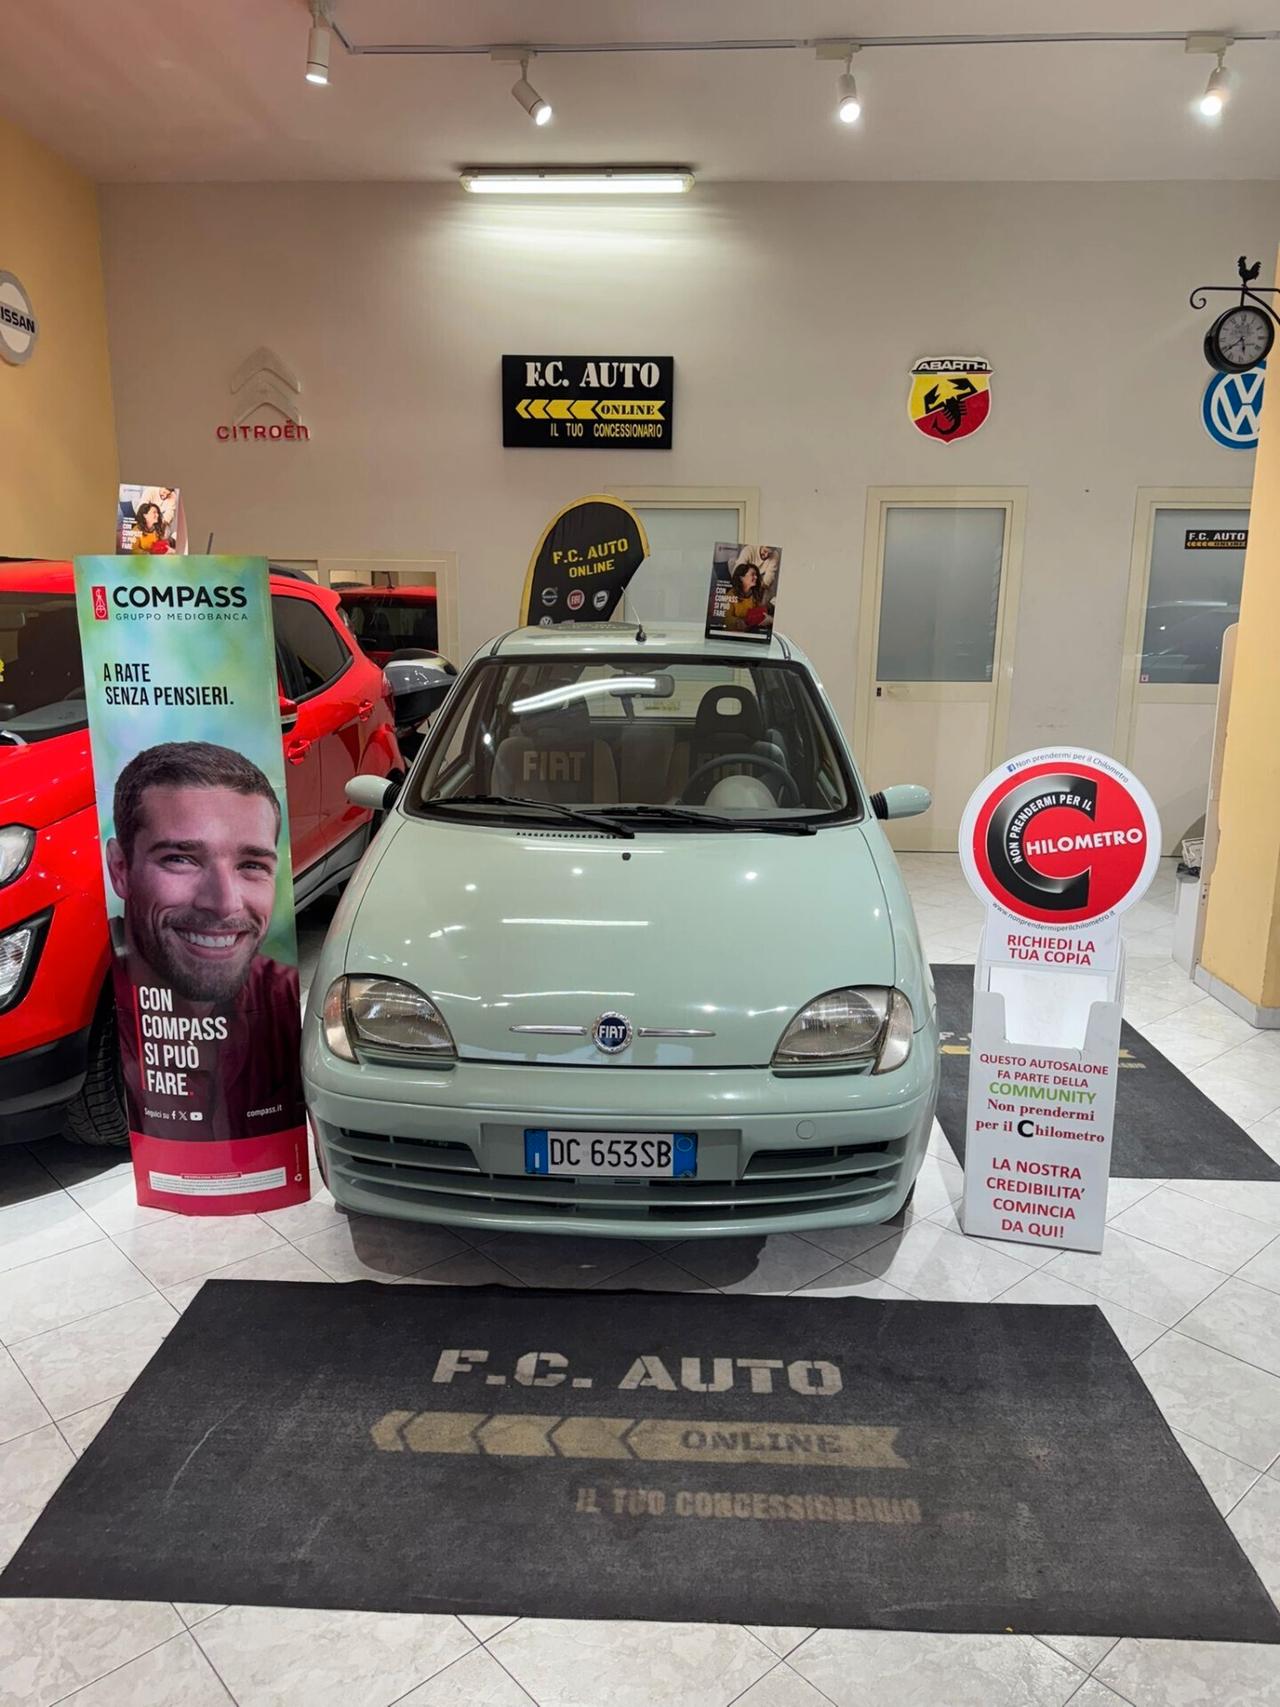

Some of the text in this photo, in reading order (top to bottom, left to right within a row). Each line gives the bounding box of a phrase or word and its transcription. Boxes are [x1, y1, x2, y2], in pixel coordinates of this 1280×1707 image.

[0, 306, 35, 333] ISSAN
[525, 361, 661, 388] F.C. AUTO
[918, 361, 986, 371] ABARTH
[601, 405, 655, 415] ONLINE
[550, 423, 663, 438] IL TUO CONCESSIONARIO
[1189, 532, 1246, 541] F.C. AUTO
[552, 538, 629, 565] F.C. AUTO
[569, 559, 615, 578] ONLINE
[113, 586, 248, 608] COMPASS
[115, 613, 249, 621] GRUPPO MEDIOBANCA
[103, 663, 151, 682] A RATE
[105, 687, 235, 705] SENZA PENSIERI.
[522, 751, 586, 781] FIAT
[1016, 758, 1032, 769] Non
[1032, 752, 1072, 763] prendermi
[1073, 753, 1085, 761] per
[1093, 757, 1129, 784] Chilometro
[1009, 794, 1092, 864] NON PRENDERMI PER IL
[1007, 934, 1095, 953] RICHIEDI LA
[1009, 947, 1092, 966] TUA COPIA
[139, 986, 173, 1011] CON
[142, 1015, 228, 1041] COMPASS
[598, 1025, 625, 1039] FIAT
[145, 1040, 200, 1069] SI PUÒ
[980, 1053, 1027, 1067] QUESTO
[1029, 1058, 1109, 1076] AUTOSALONE
[997, 1070, 1089, 1088] FA PARTE DELLA
[989, 1081, 1097, 1105] COMMUNITY
[144, 1107, 162, 1119] Seguici
[162, 1112, 170, 1120] su
[246, 1104, 283, 1118] compass.it
[987, 1099, 1095, 1121] Non prendermi
[975, 1119, 1105, 1144] per il Chilometro
[549, 1138, 581, 1166] DC
[591, 1139, 672, 1168] 653SB
[992, 1157, 1082, 1180] LA NOSTRA
[986, 1176, 1085, 1200] CREDIBILITA'
[993, 1197, 1076, 1220] COMINCIA
[1001, 1219, 1065, 1238] DA QUI!
[432, 1349, 844, 1395] F.C. AUTO
[681, 1430, 844, 1454] ONLINE
[575, 1487, 922, 1524] IL TUO CONCESSIONARIO
